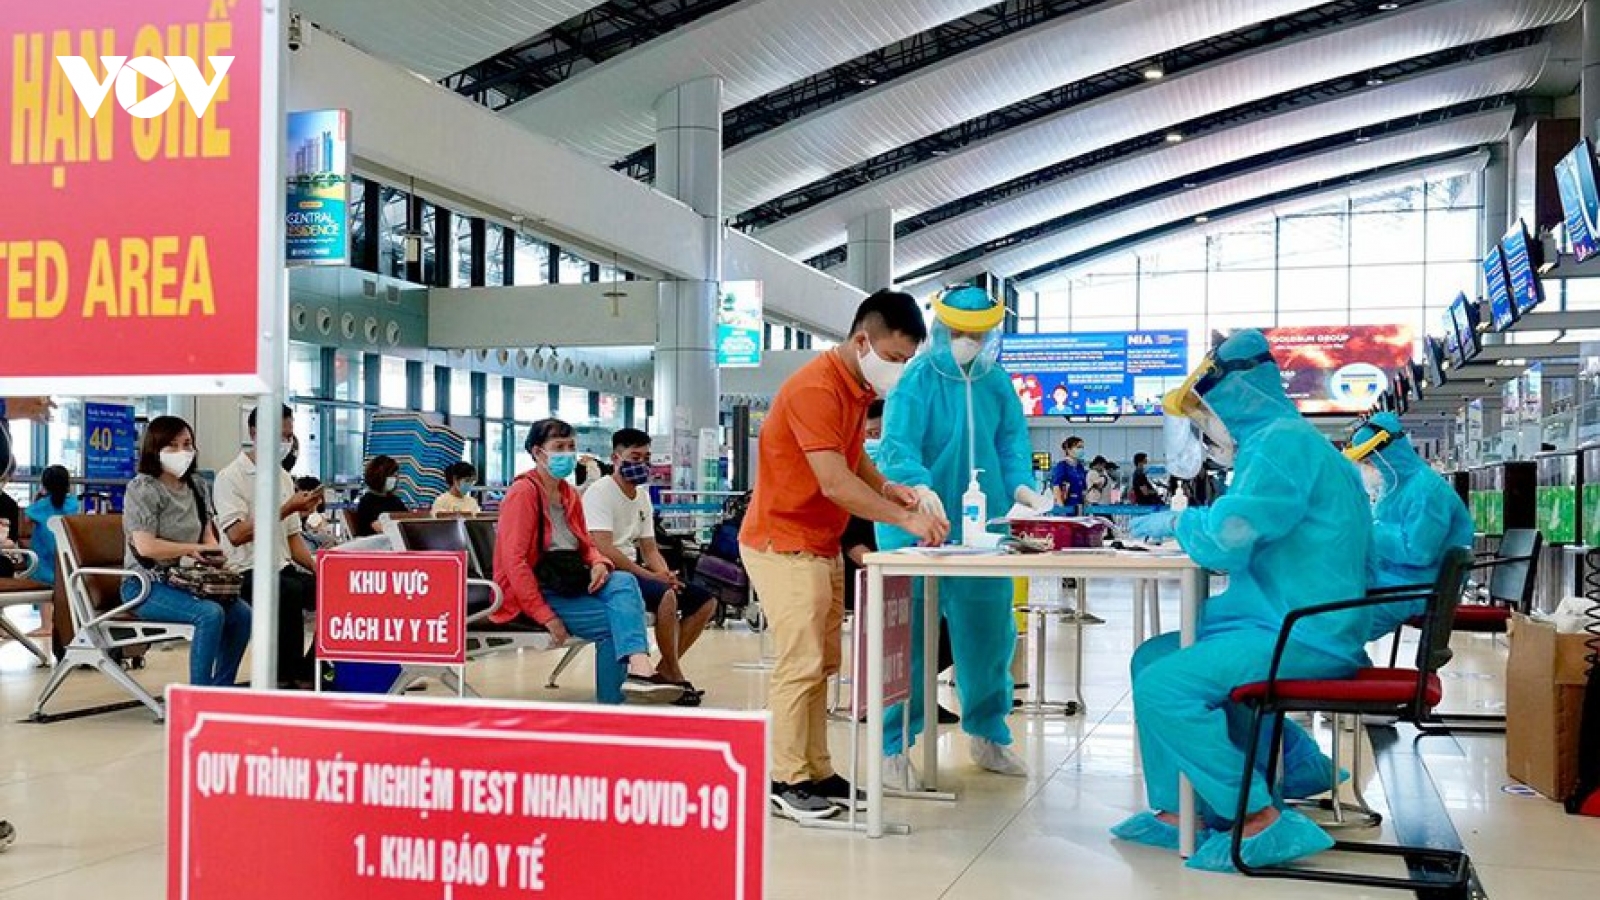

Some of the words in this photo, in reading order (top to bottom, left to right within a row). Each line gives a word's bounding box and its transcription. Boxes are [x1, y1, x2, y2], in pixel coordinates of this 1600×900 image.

[0, 240, 69, 319] ED
[82, 235, 216, 318] AREA
[89, 426, 113, 451] 40
[350, 570, 387, 594] KHU
[391, 569, 429, 600] VỰC
[330, 612, 379, 640] CÁCH
[384, 617, 404, 642] LY
[409, 618, 422, 642] Y
[426, 612, 450, 643] TẾ
[196, 751, 240, 797] QUY
[245, 746, 311, 800] TRÌNH
[315, 752, 358, 804] XÉT
[362, 757, 454, 819] NGHIỆM
[459, 769, 517, 816] TEST
[522, 773, 608, 822] NHANH
[614, 778, 729, 831] COVID-19
[354, 834, 375, 876] 1.
[380, 835, 436, 882] KHAI
[441, 832, 489, 886] BÁO
[495, 844, 511, 888] Y
[516, 832, 547, 890] TẾ
